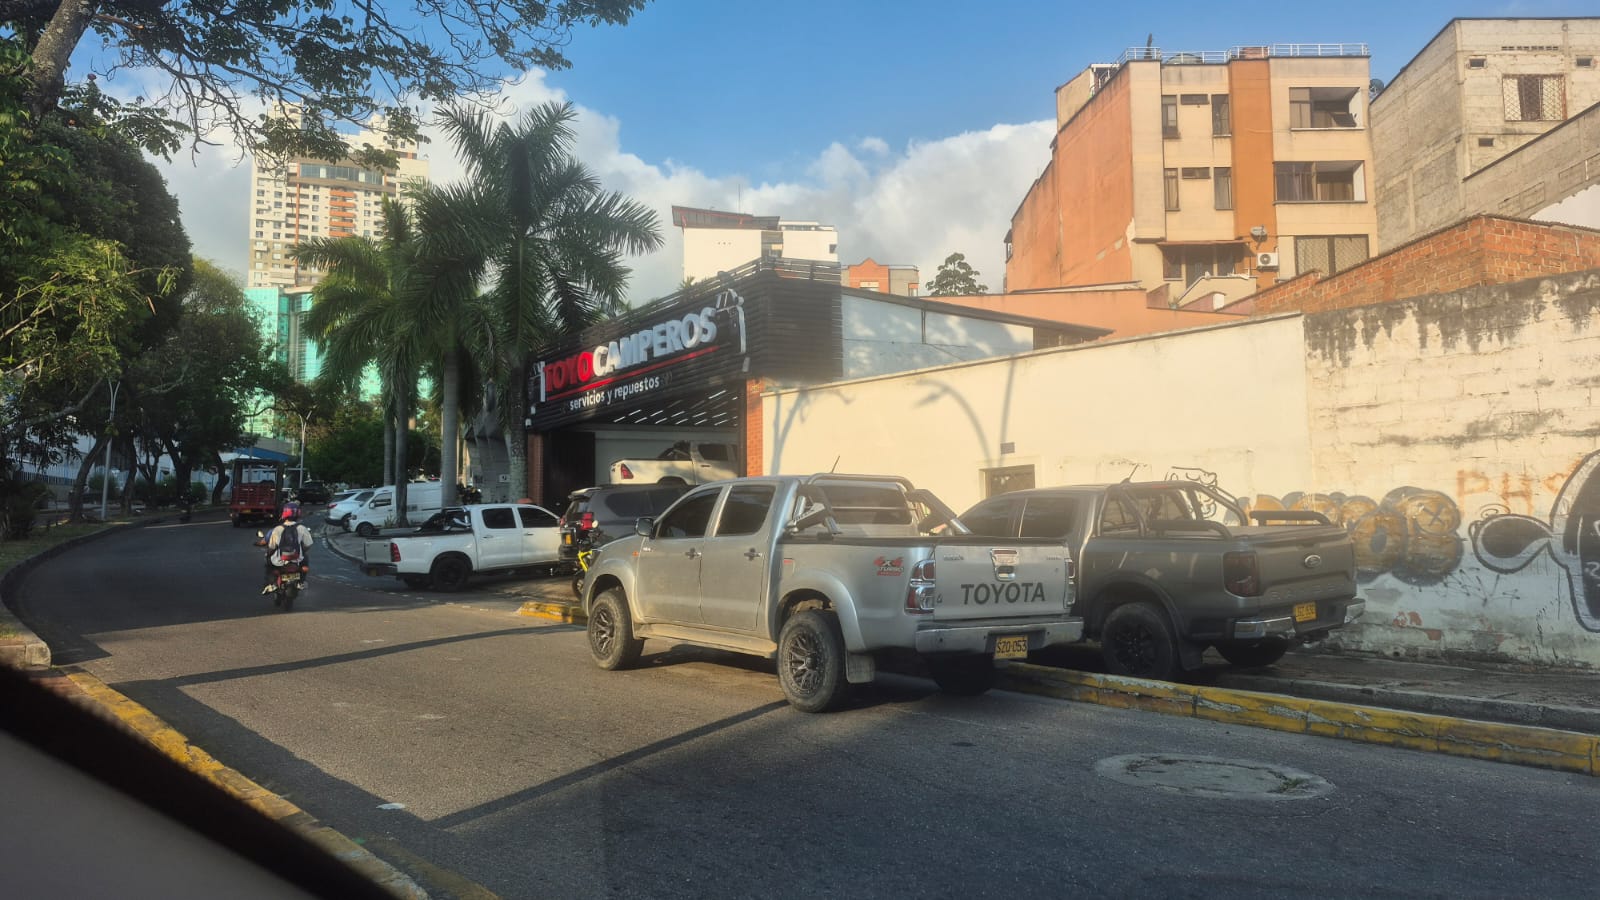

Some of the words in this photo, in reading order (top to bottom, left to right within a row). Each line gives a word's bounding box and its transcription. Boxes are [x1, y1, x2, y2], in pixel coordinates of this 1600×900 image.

[543, 306, 717, 392] TOYOCAMPEROS
[569, 388, 606, 411] servicios
[607, 389, 613, 405] y
[614, 375, 660, 401] repuestos
[960, 582, 1046, 605] TOYOTA
